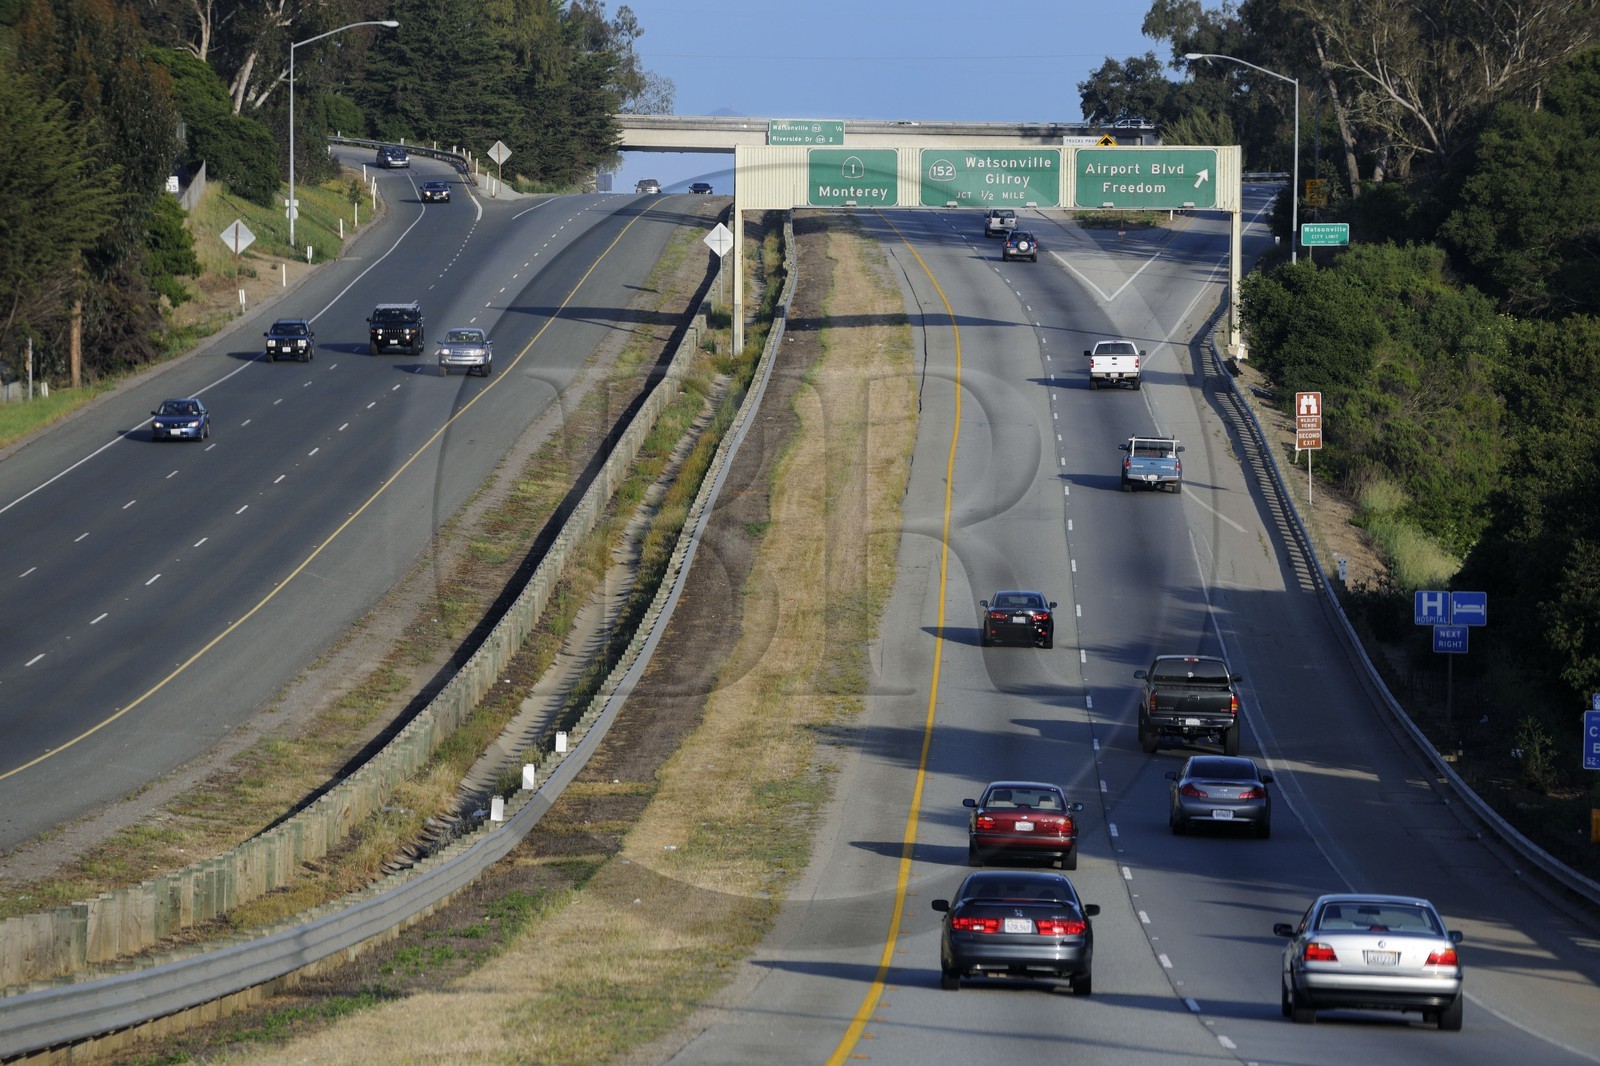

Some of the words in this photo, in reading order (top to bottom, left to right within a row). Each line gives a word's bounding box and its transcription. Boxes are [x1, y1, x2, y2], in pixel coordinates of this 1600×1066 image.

[965, 156, 1051, 168] Watsonville
[850, 163, 856, 174] 1
[932, 166, 953, 176] 152
[1085, 163, 1140, 176] Airport
[1151, 163, 1184, 174] Blvd
[985, 173, 1030, 188] Gilroy
[819, 186, 888, 200] Monterey
[1103, 182, 1166, 193] Freedom
[955, 191, 972, 199] JCT
[981, 190, 994, 201] 1/2
[1002, 191, 1025, 199] MILE
[1422, 592, 1443, 616] H
[1416, 616, 1448, 624] HOSPITAL
[1440, 630, 1461, 638] NEXT
[1438, 640, 1463, 648] RIGHT
